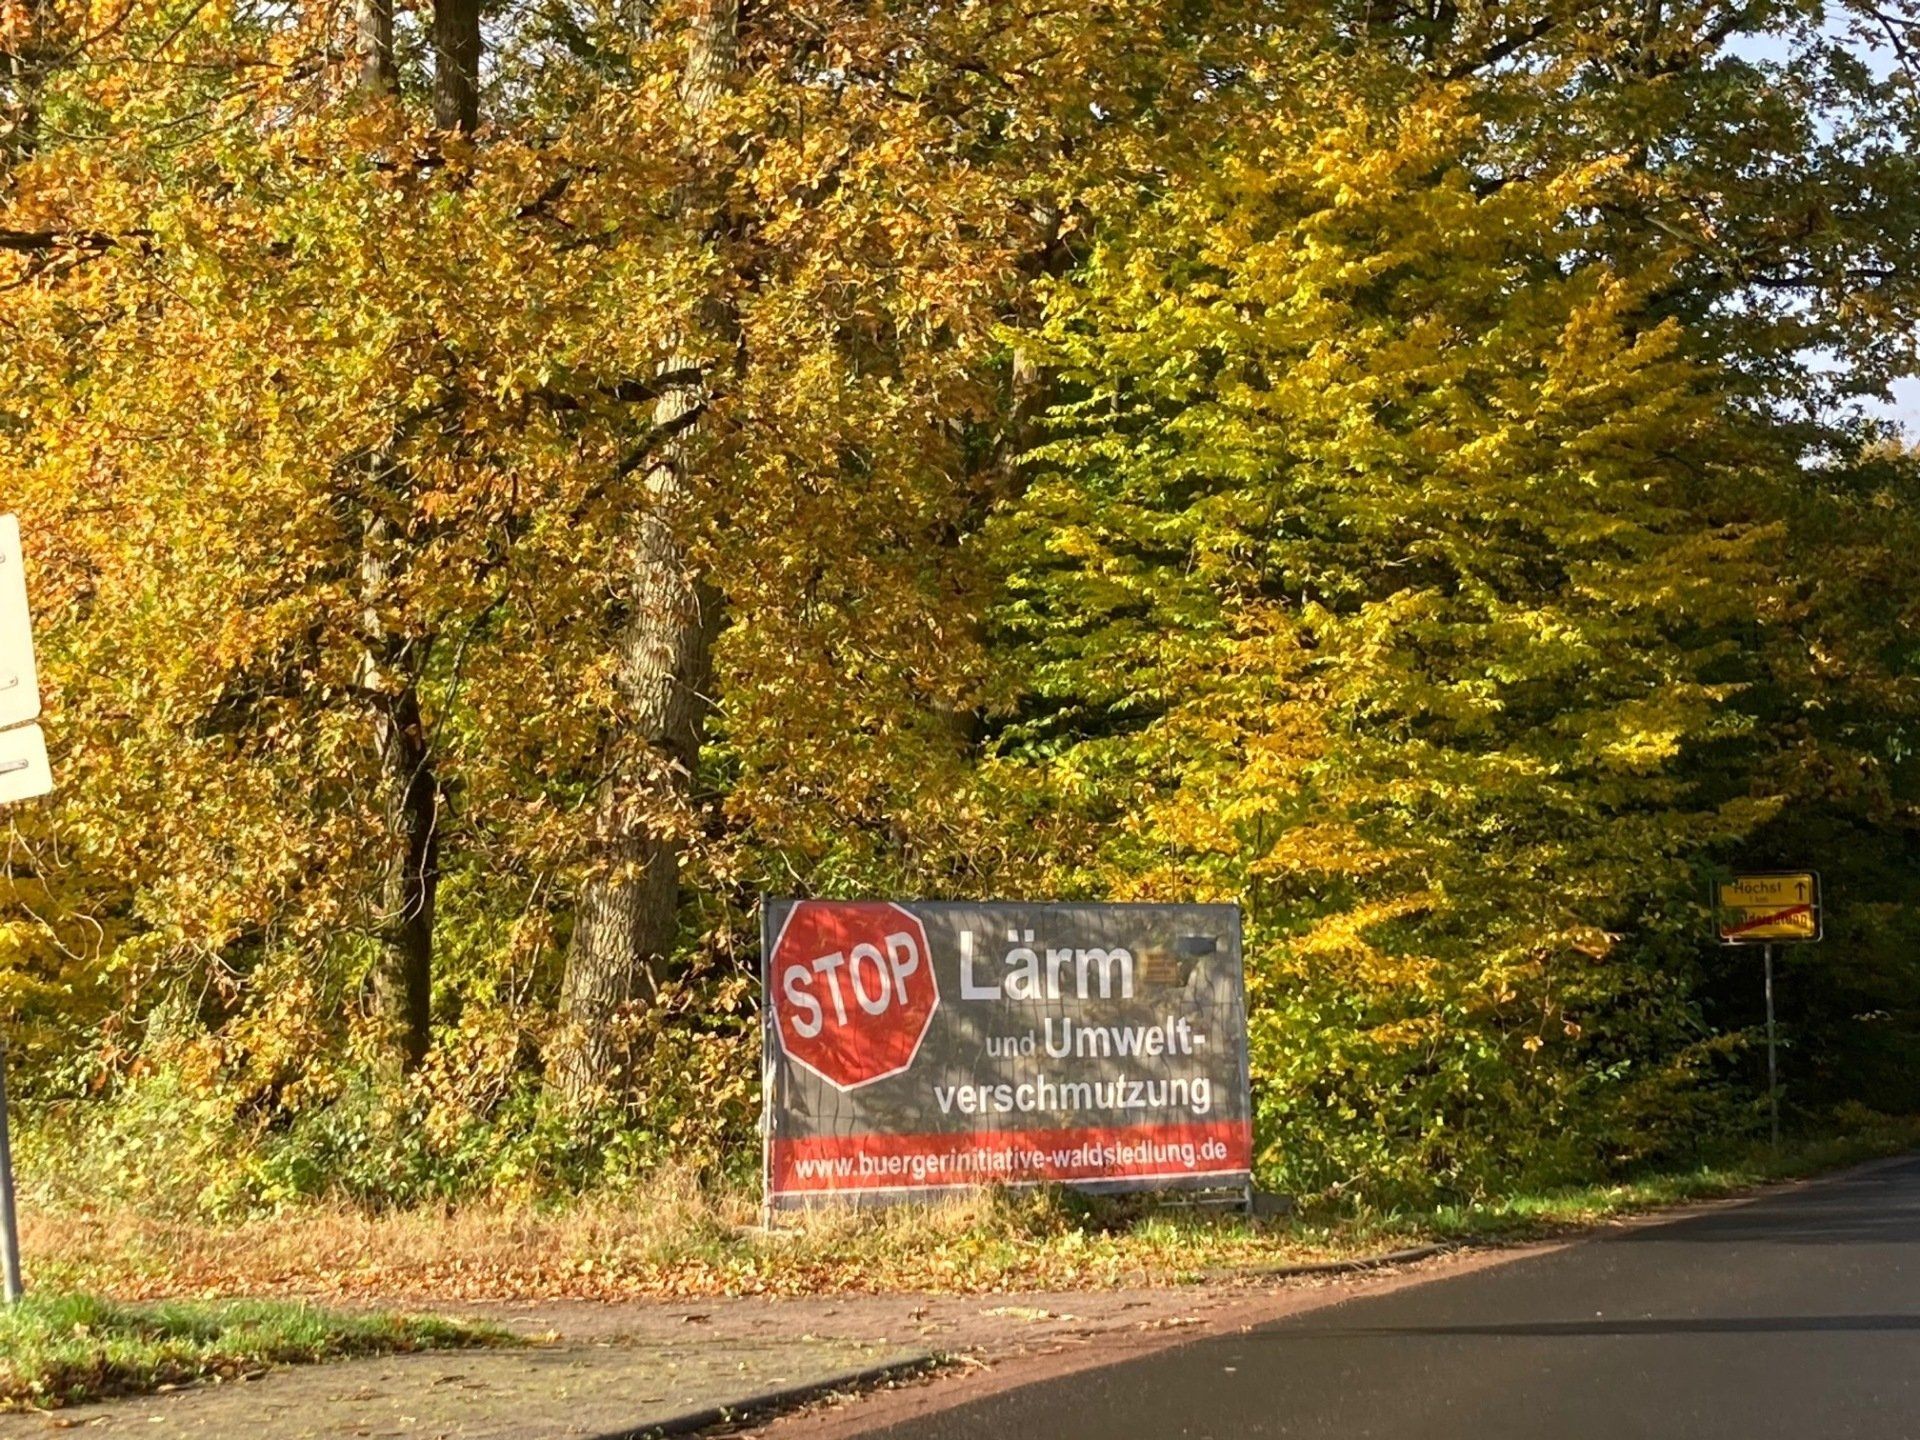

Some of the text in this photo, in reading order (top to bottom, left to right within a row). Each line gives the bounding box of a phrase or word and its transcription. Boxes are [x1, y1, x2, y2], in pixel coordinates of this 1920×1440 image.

[783, 931, 919, 1039] STOP
[959, 929, 1132, 1000] Lärm
[986, 1017, 1206, 1058] und Umwelt-
[934, 1074, 1211, 1115] verschmutzung
[795, 1137, 1228, 1180] www.buergerinitiative-waldsiedlung.de
